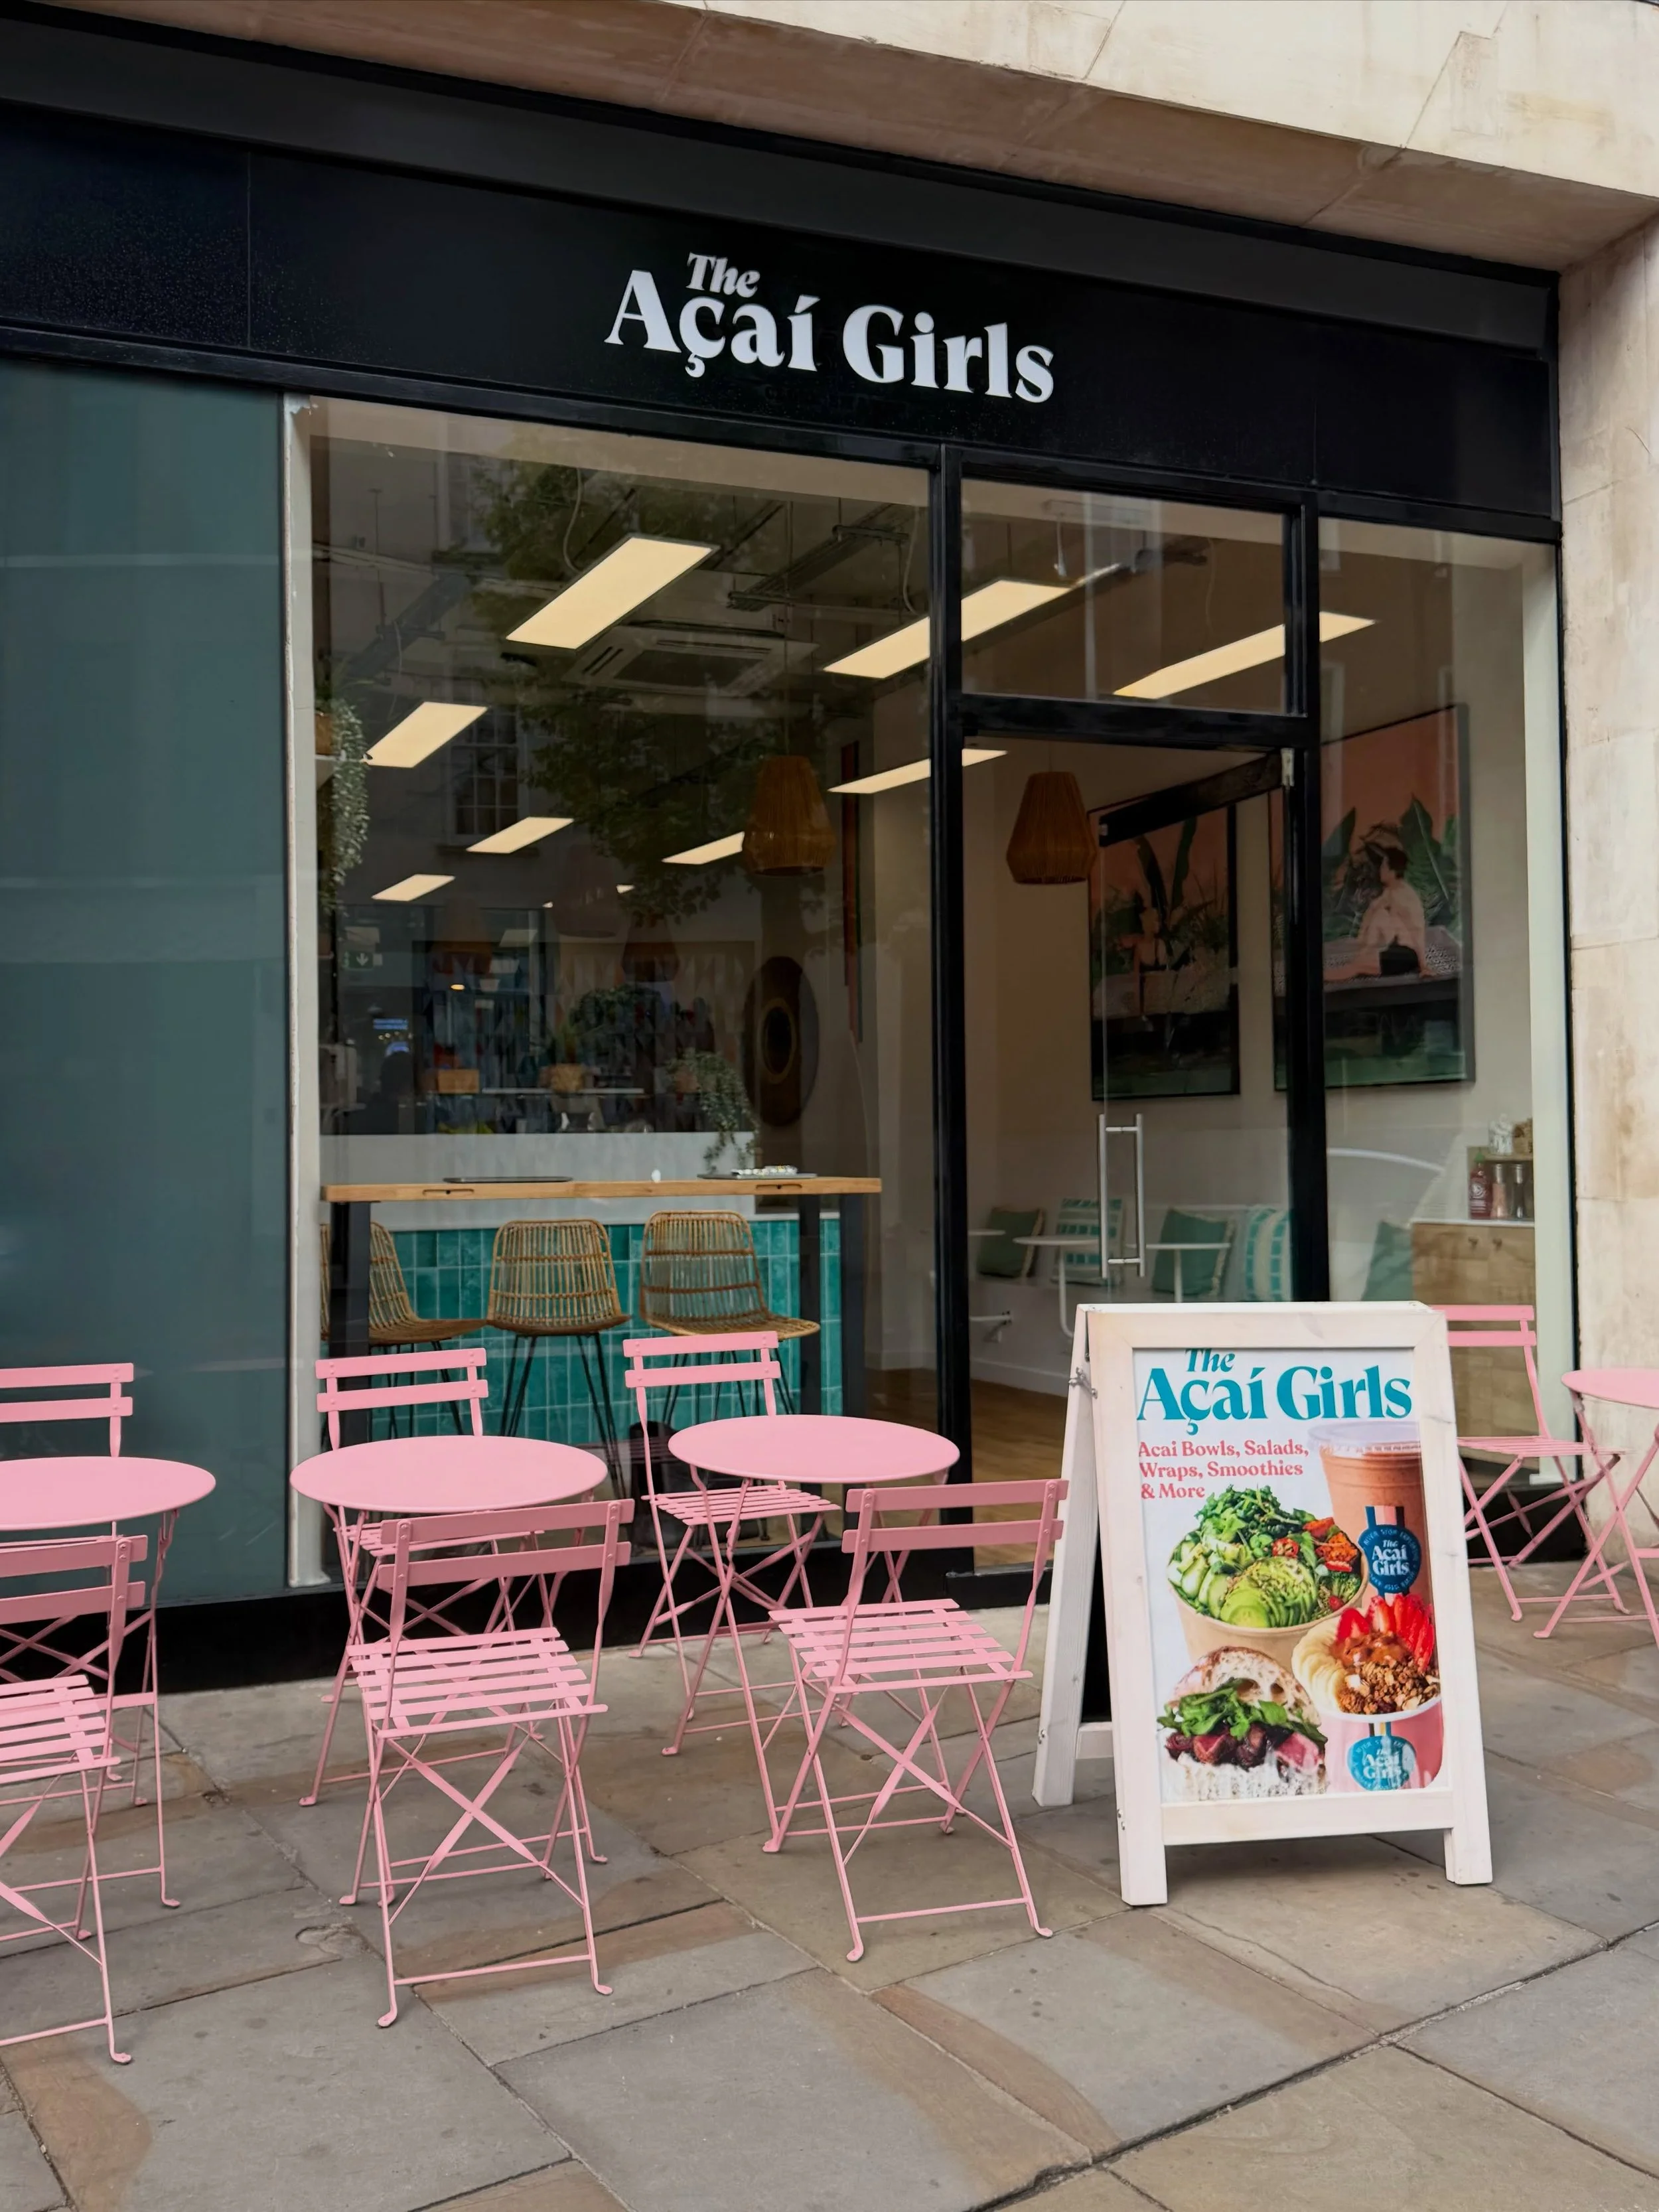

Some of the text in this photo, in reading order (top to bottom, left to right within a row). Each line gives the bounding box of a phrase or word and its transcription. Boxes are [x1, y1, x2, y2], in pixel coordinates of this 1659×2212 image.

[686, 252, 760, 298] The
[604, 269, 1054, 403] Açaí Girls
[1185, 1348, 1235, 1372] The
[1137, 1365, 1412, 1436] Açaí Girls
[1139, 1439, 1309, 1457] Acai Bowls, Salads,
[1139, 1461, 1303, 1482] Wraps, Smoothies
[1141, 1483, 1205, 1500] & More
[1382, 1539, 1399, 1548] The
[1372, 1560, 1410, 1576] Girls
